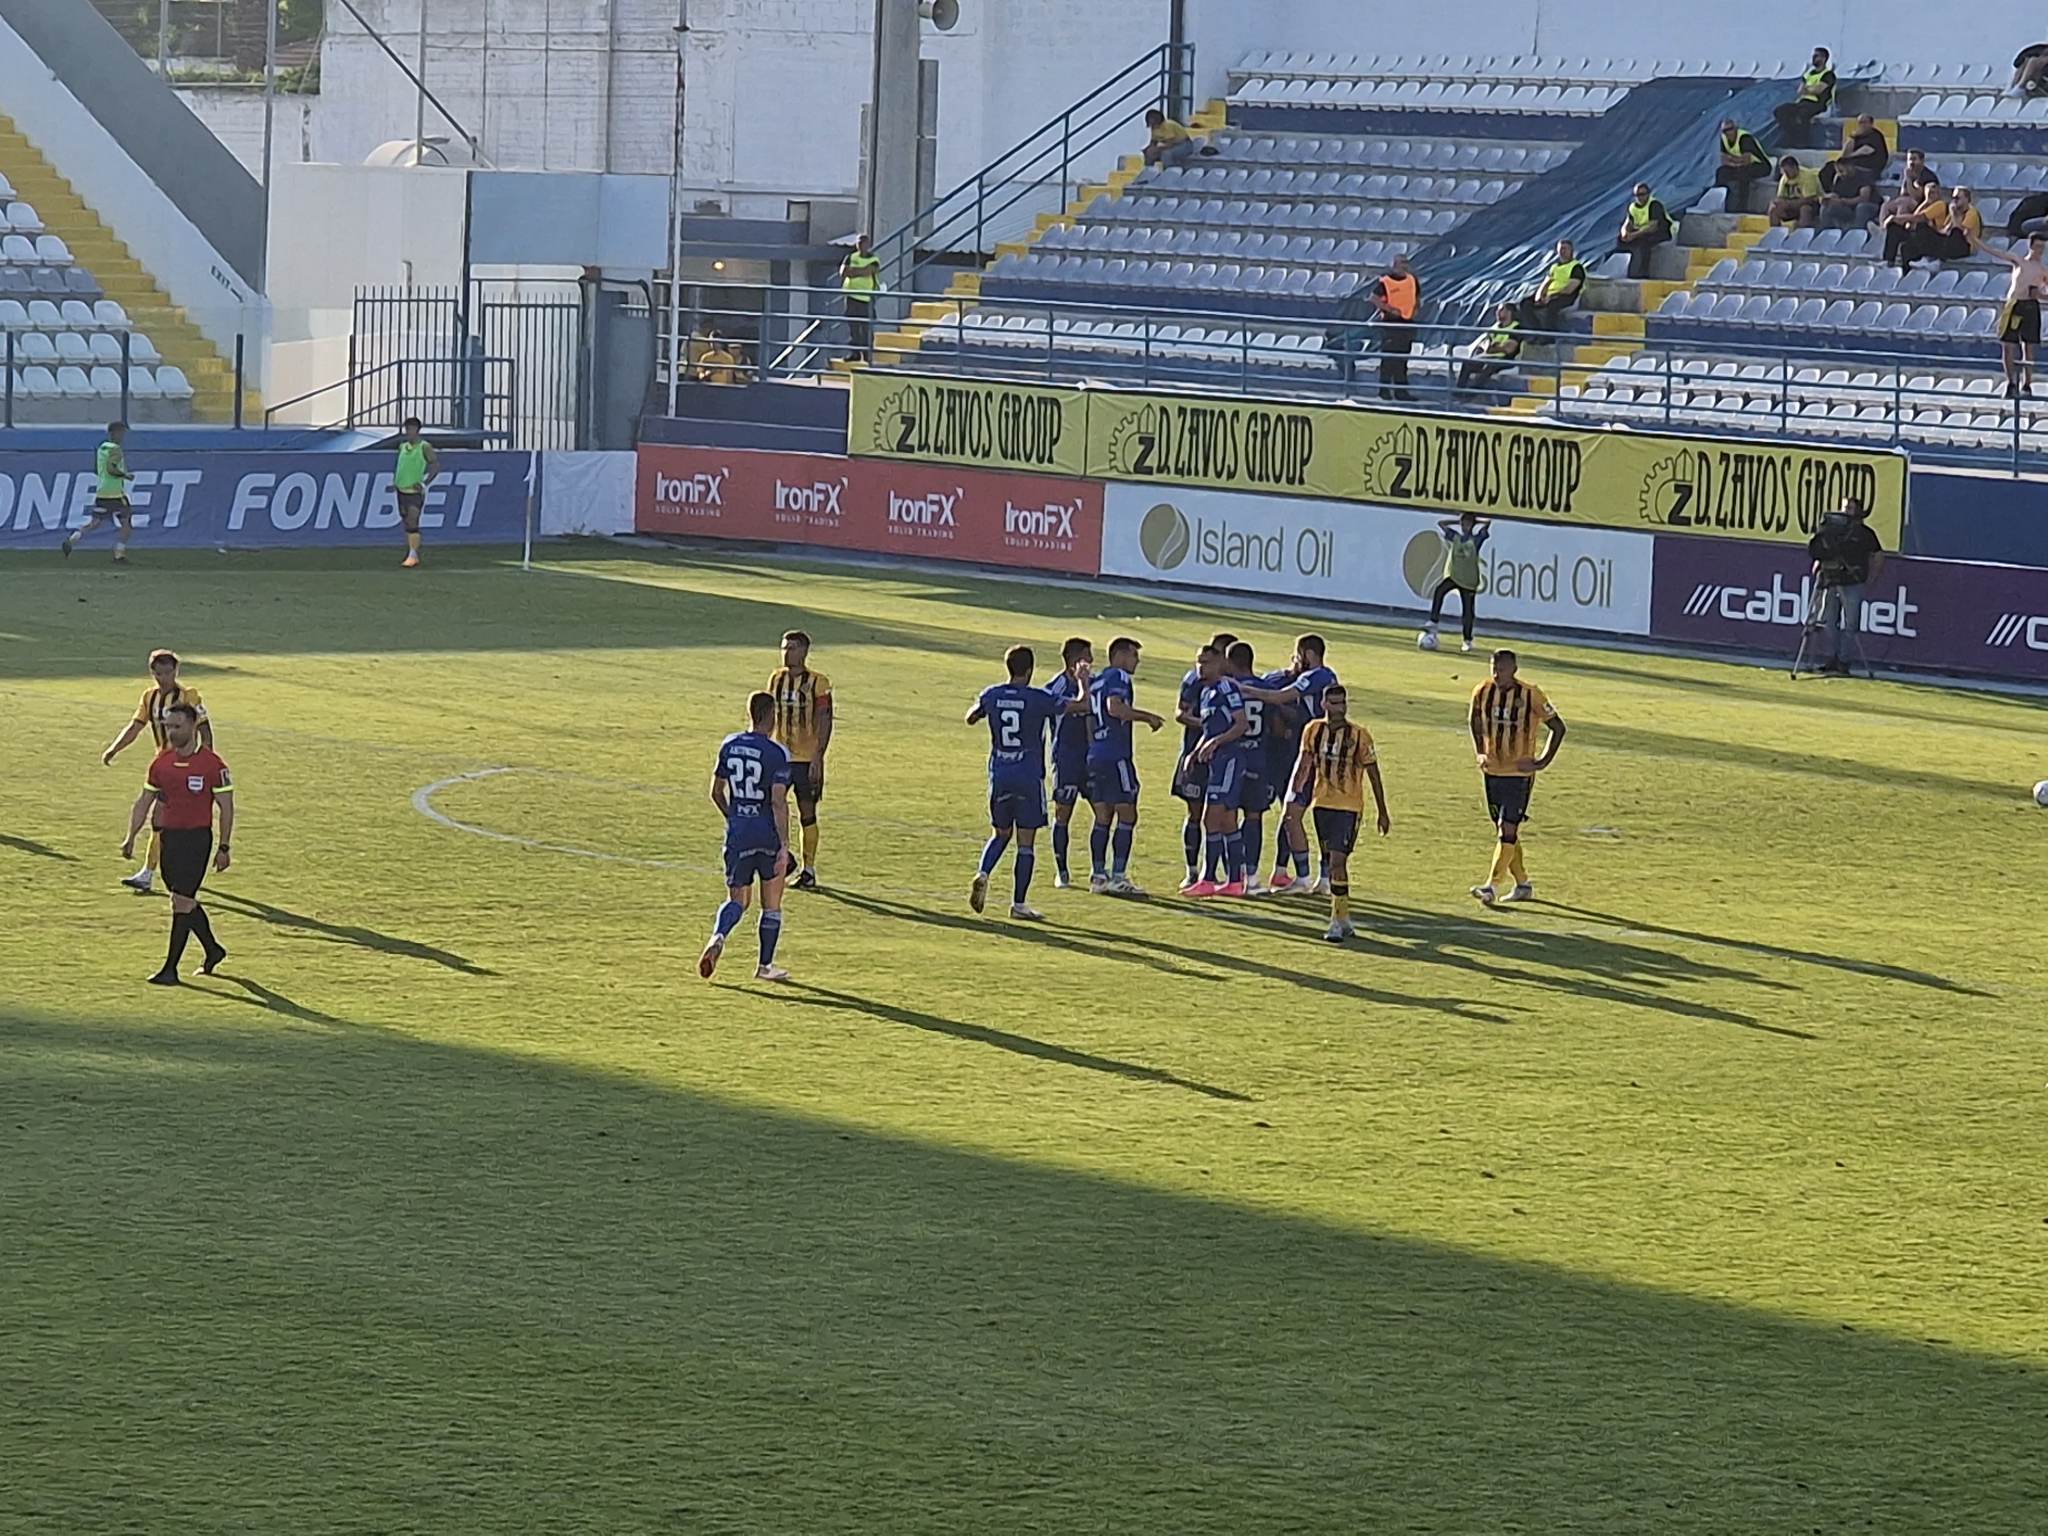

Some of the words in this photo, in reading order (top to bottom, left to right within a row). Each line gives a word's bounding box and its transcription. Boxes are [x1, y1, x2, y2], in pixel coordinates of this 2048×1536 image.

[934, 387, 993, 460] ZAVOS
[998, 392, 1062, 464] GROUP
[1174, 406, 1240, 481] ZAVOS
[1245, 411, 1313, 486] GROUP
[656, 471, 722, 505] IronFX
[1432, 426, 1502, 506] ZAVOS
[1507, 434, 1581, 513] GROUP
[1715, 451, 1791, 534] ZAVOS
[227, 471, 494, 530] FONBET
[776, 479, 841, 515] IronFX
[889, 490, 954, 527] IronFX
[1006, 501, 1073, 538] IronFX
[1196, 517, 1283, 573] Island
[1296, 528, 1333, 578] Oil
[1477, 547, 1558, 602] sland
[1572, 556, 1612, 608] Oil
[1001, 711, 1021, 747] 2
[1244, 700, 1264, 736] 5
[727, 758, 765, 800] 22
